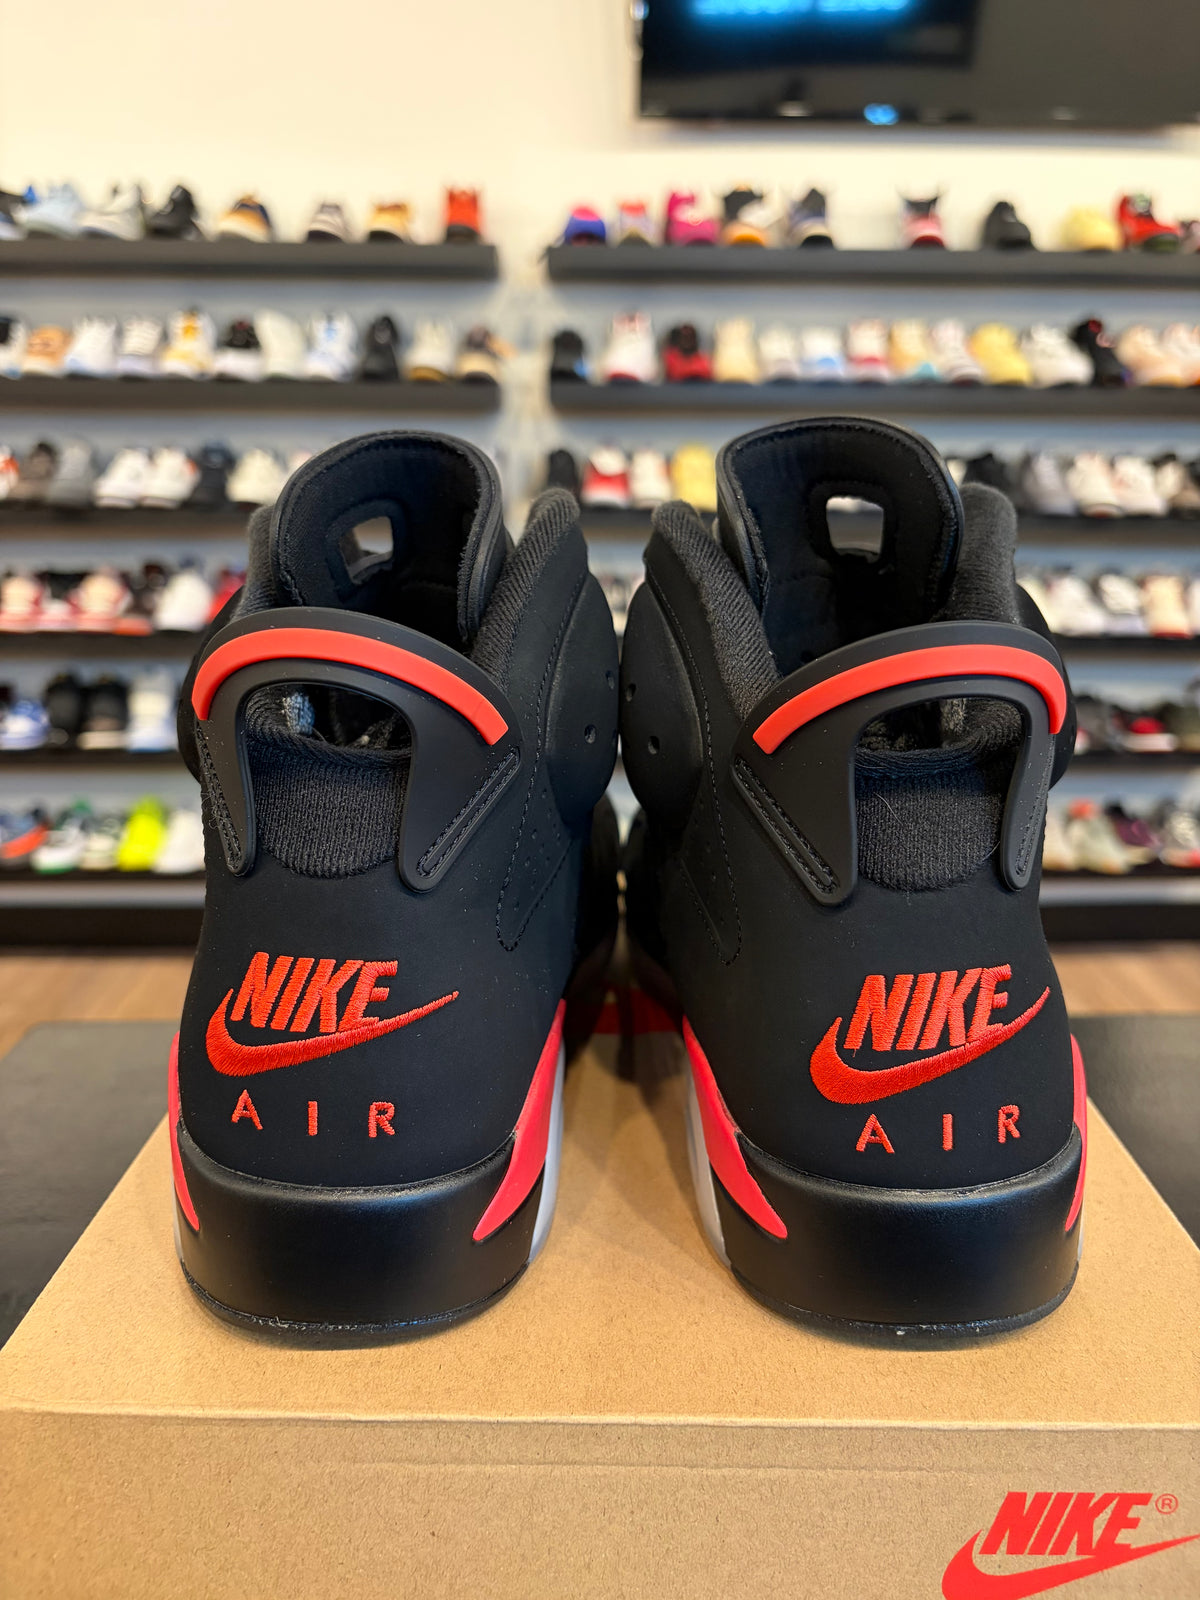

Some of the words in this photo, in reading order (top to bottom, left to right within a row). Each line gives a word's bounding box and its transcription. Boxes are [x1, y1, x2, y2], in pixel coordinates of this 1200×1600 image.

[230, 951, 399, 1034] NIKE
[843, 963, 1012, 1051] NIKE
[231, 1088, 396, 1138] AIR
[855, 1104, 1022, 1154] AIR
